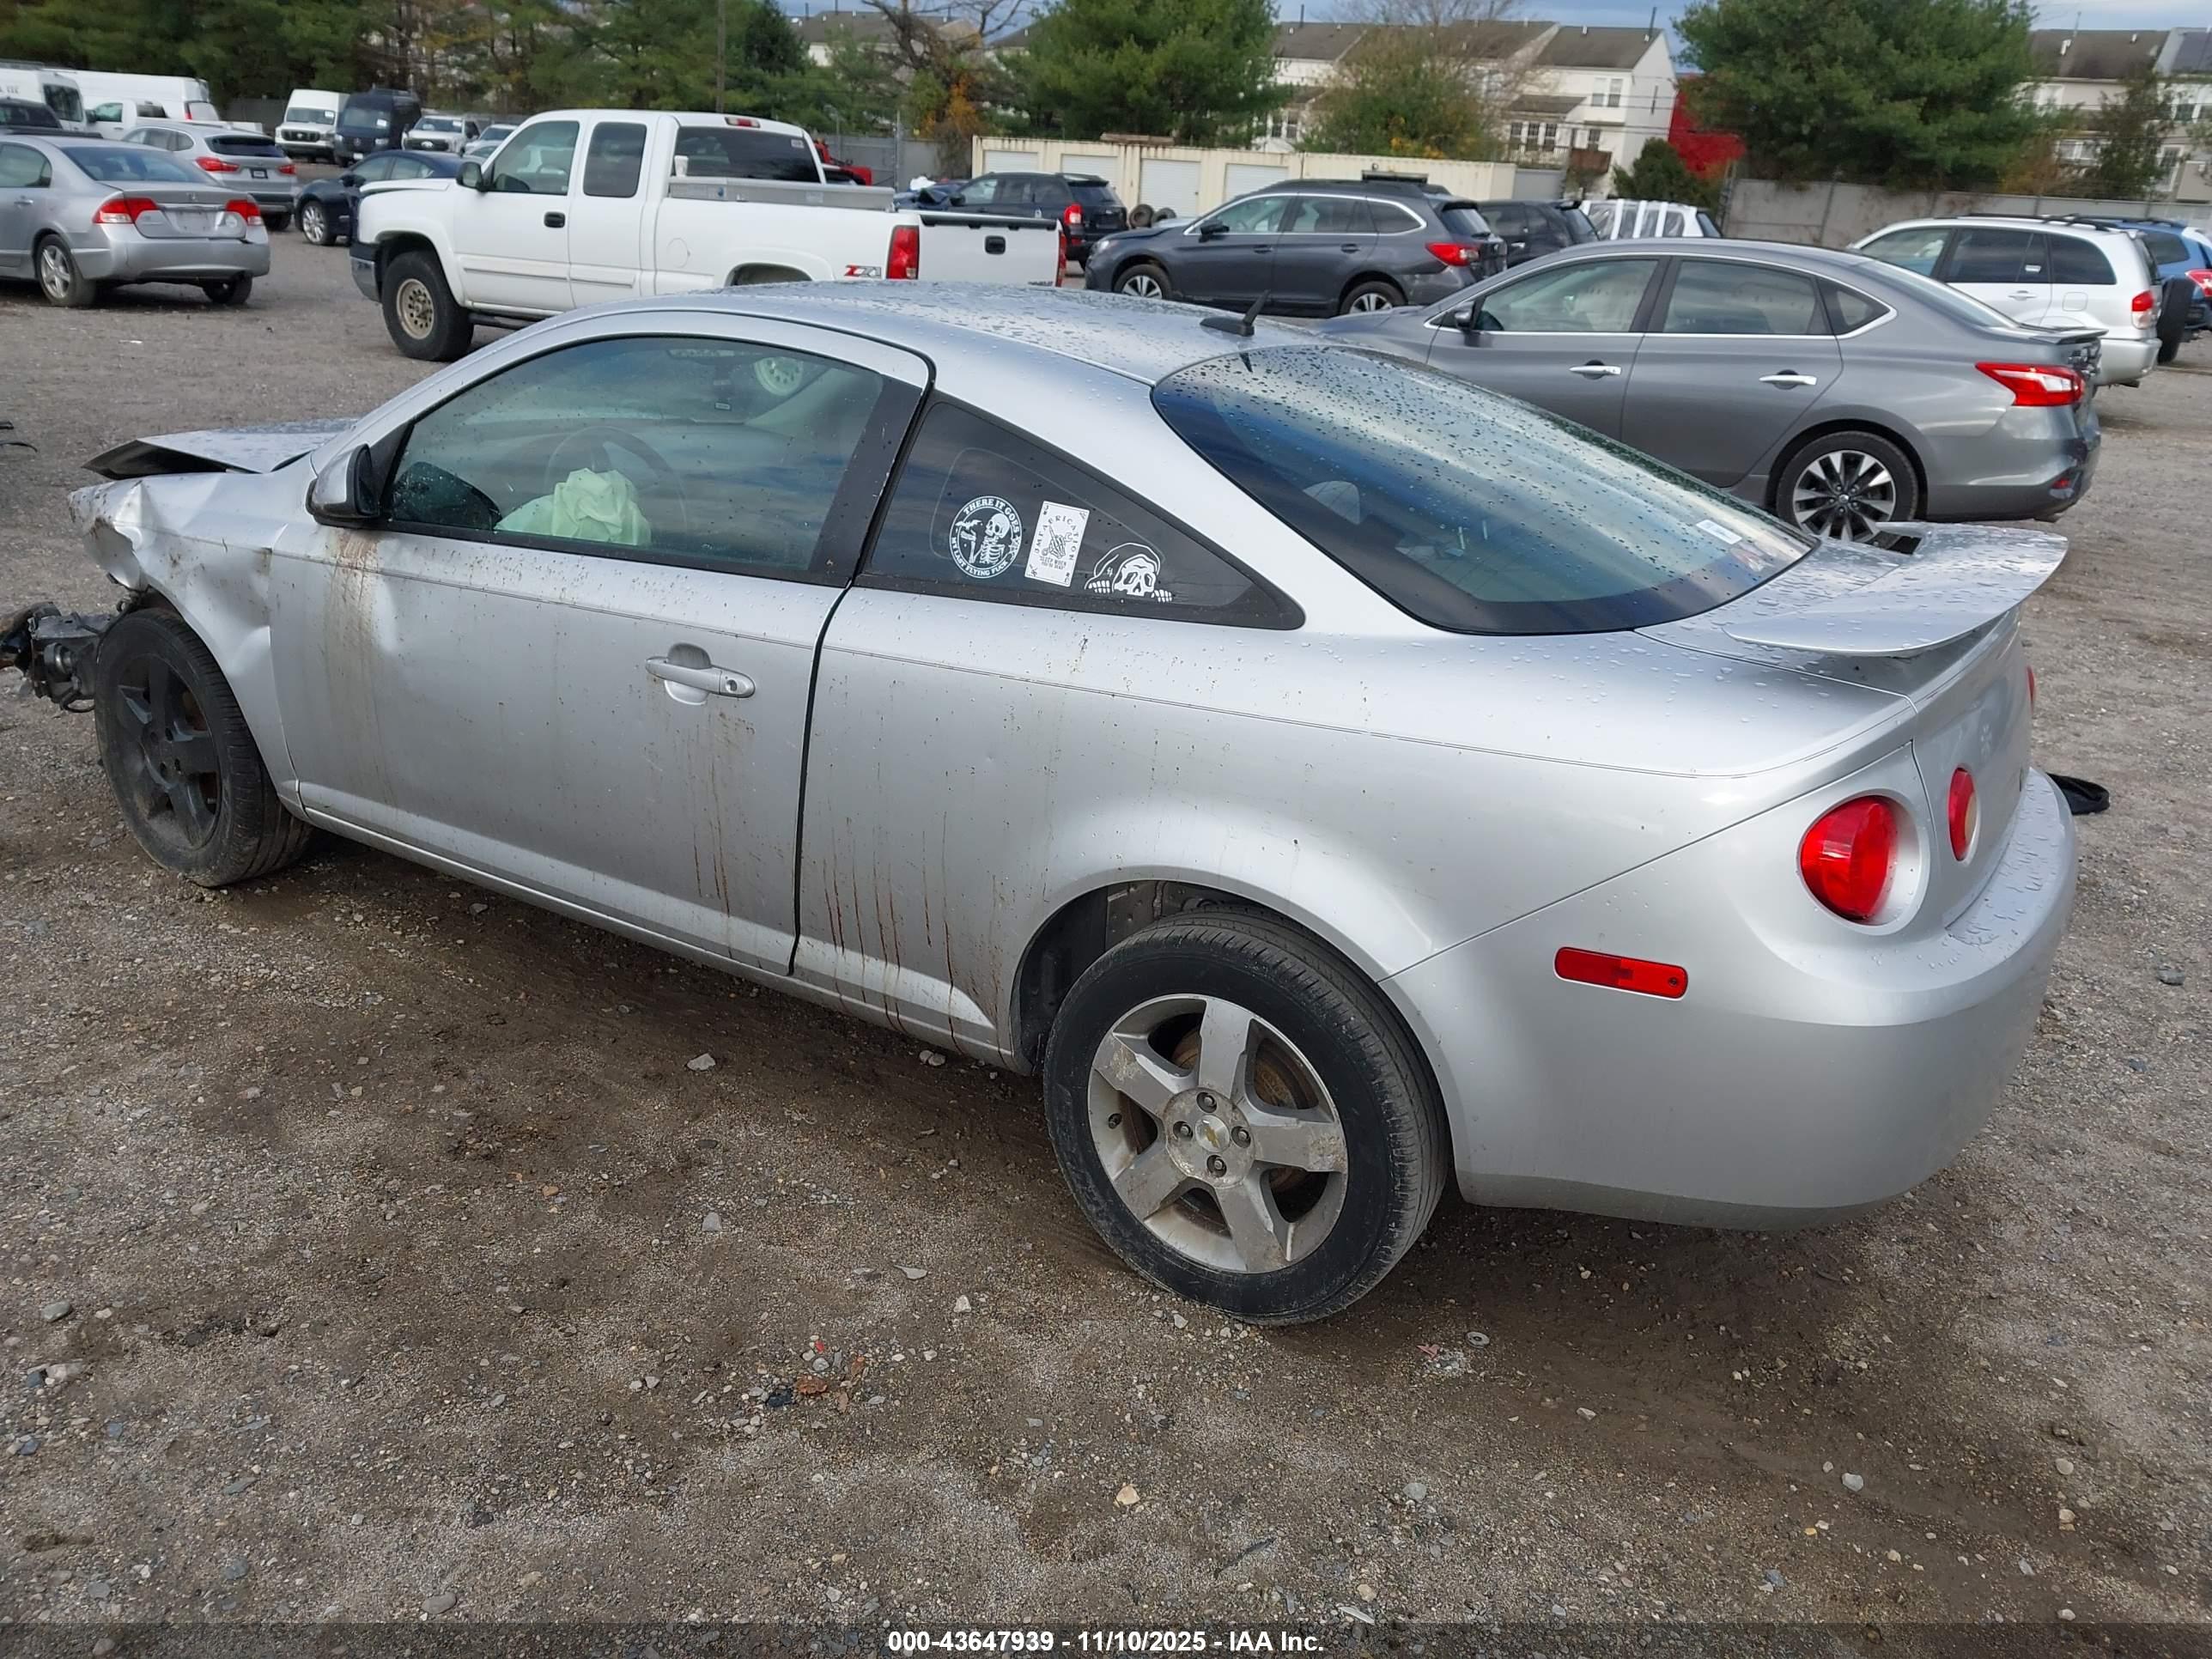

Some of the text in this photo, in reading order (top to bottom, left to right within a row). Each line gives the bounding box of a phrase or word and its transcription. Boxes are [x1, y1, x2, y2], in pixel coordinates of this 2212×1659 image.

[845, 264, 882, 278] Z71
[963, 498, 1020, 533] THERE IT GOES
[951, 537, 1010, 576] MY LAST FLYING FUCK
